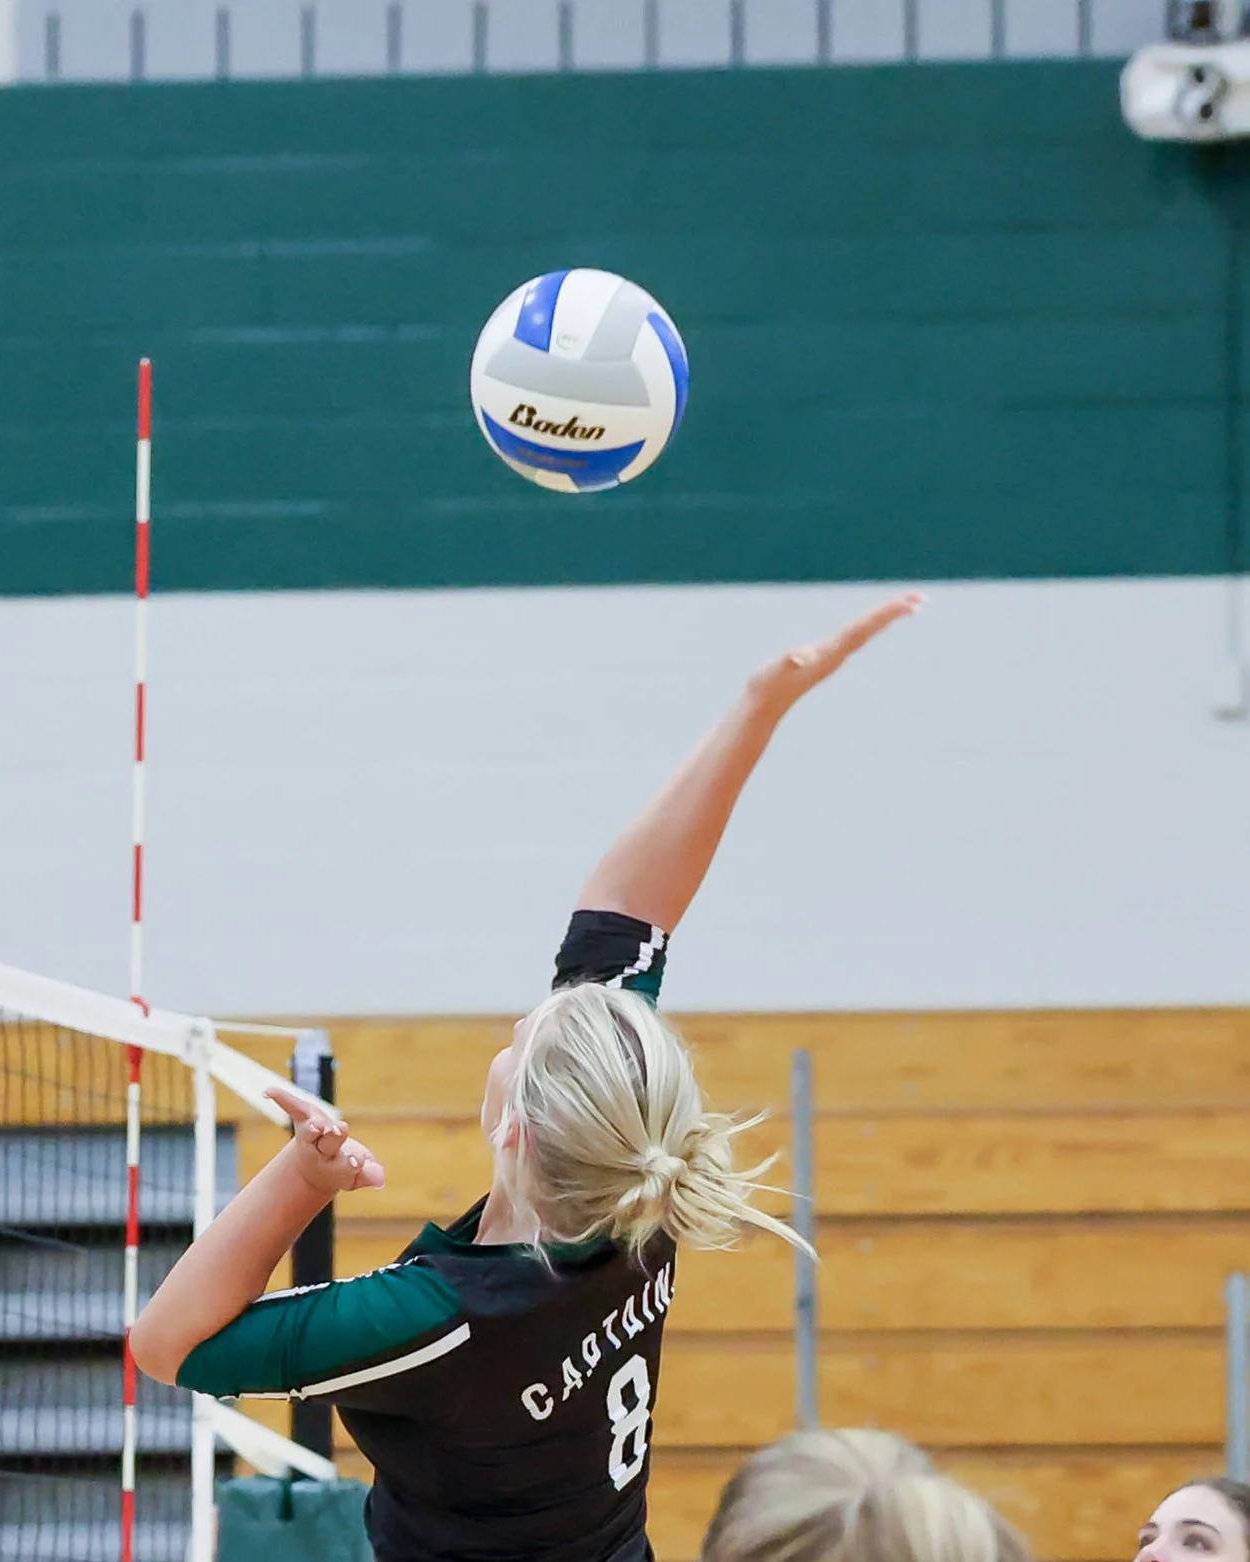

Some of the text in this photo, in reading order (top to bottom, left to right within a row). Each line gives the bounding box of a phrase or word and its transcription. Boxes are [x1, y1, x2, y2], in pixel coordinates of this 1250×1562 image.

[508, 402, 606, 441] Baden
[521, 1261, 675, 1421] CAPTAIN
[606, 1353, 651, 1492] 8
